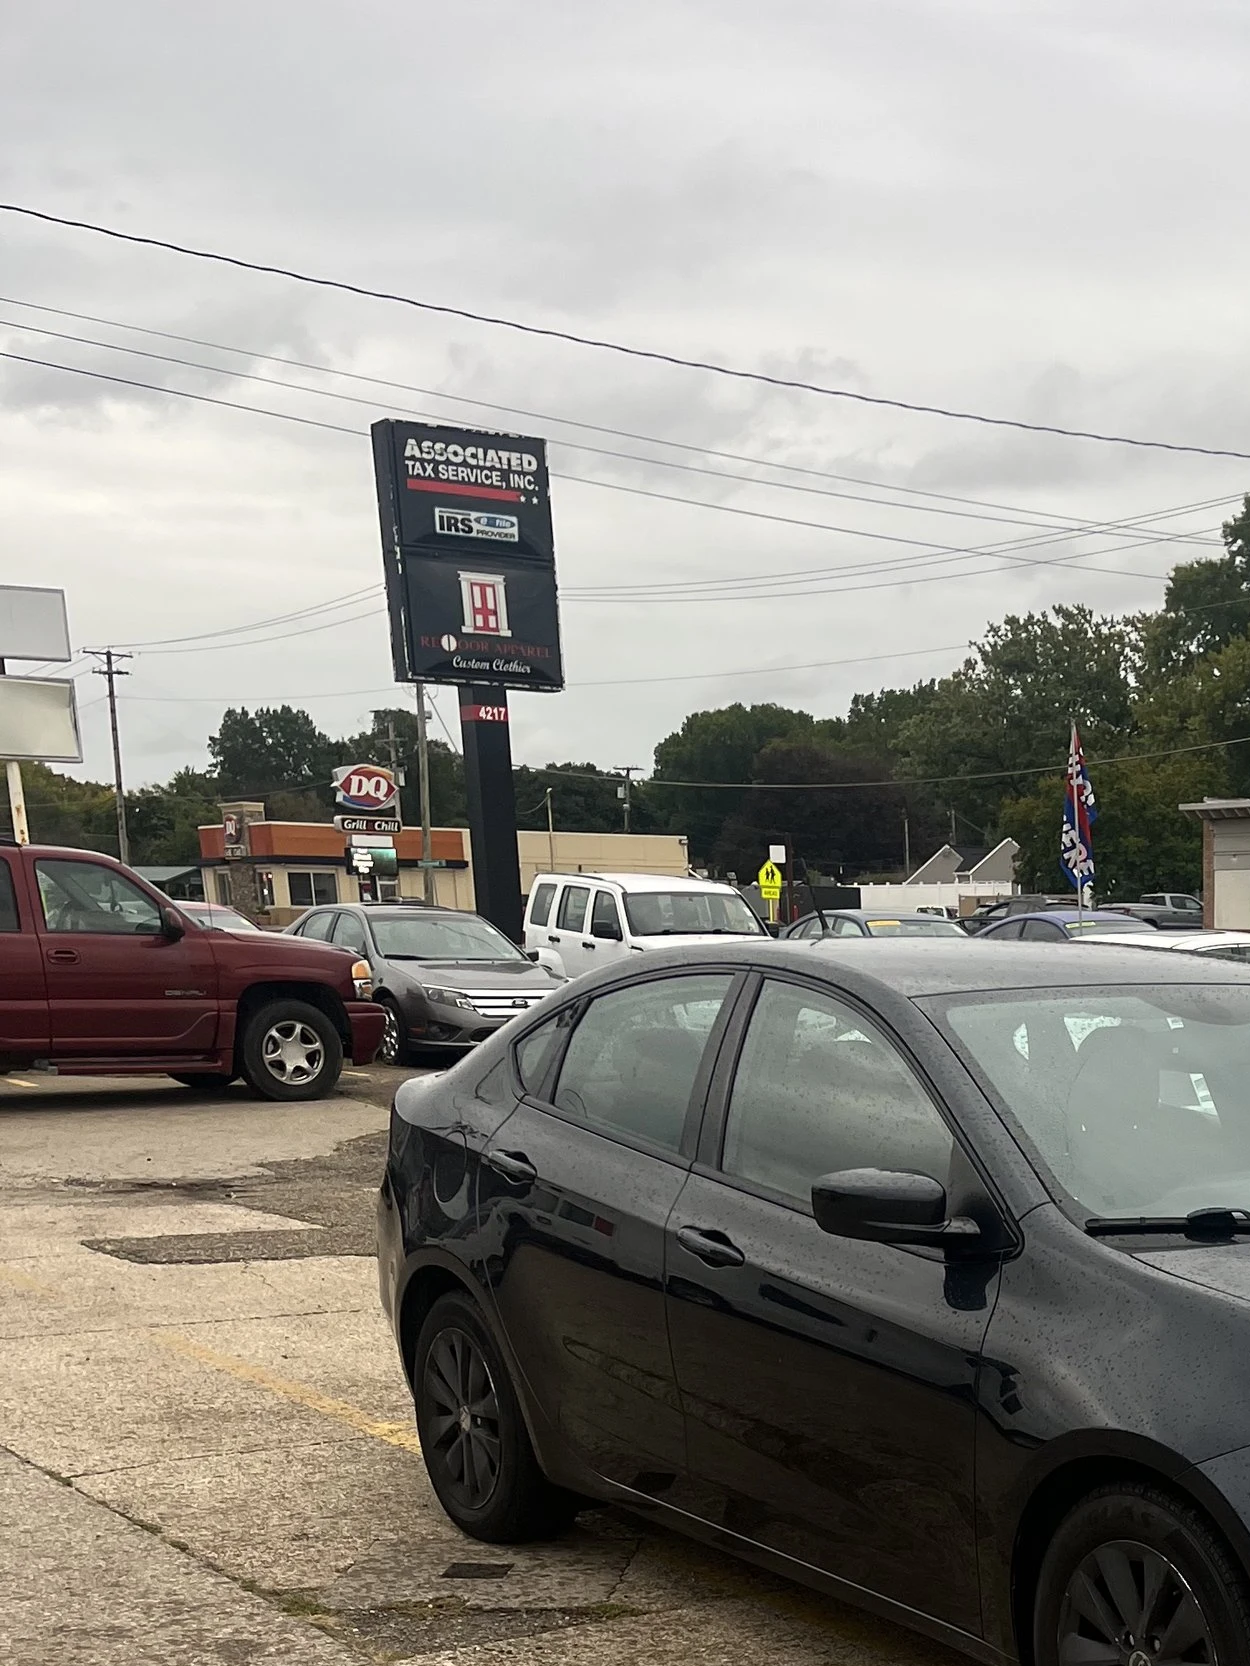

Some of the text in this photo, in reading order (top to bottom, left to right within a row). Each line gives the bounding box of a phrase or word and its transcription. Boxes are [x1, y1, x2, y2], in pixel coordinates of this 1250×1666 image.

[404, 438, 538, 472] ASSOCIATED
[404, 460, 539, 491] TAX SERVICE, INC.
[438, 514, 473, 534] IRS
[476, 529, 515, 539] PROVIDER
[495, 643, 552, 658] APPAREL
[452, 655, 531, 674] Custom Clothier
[479, 706, 505, 720] 4217
[350, 775, 387, 800] DQ
[344, 820, 399, 831] Grill Chill
